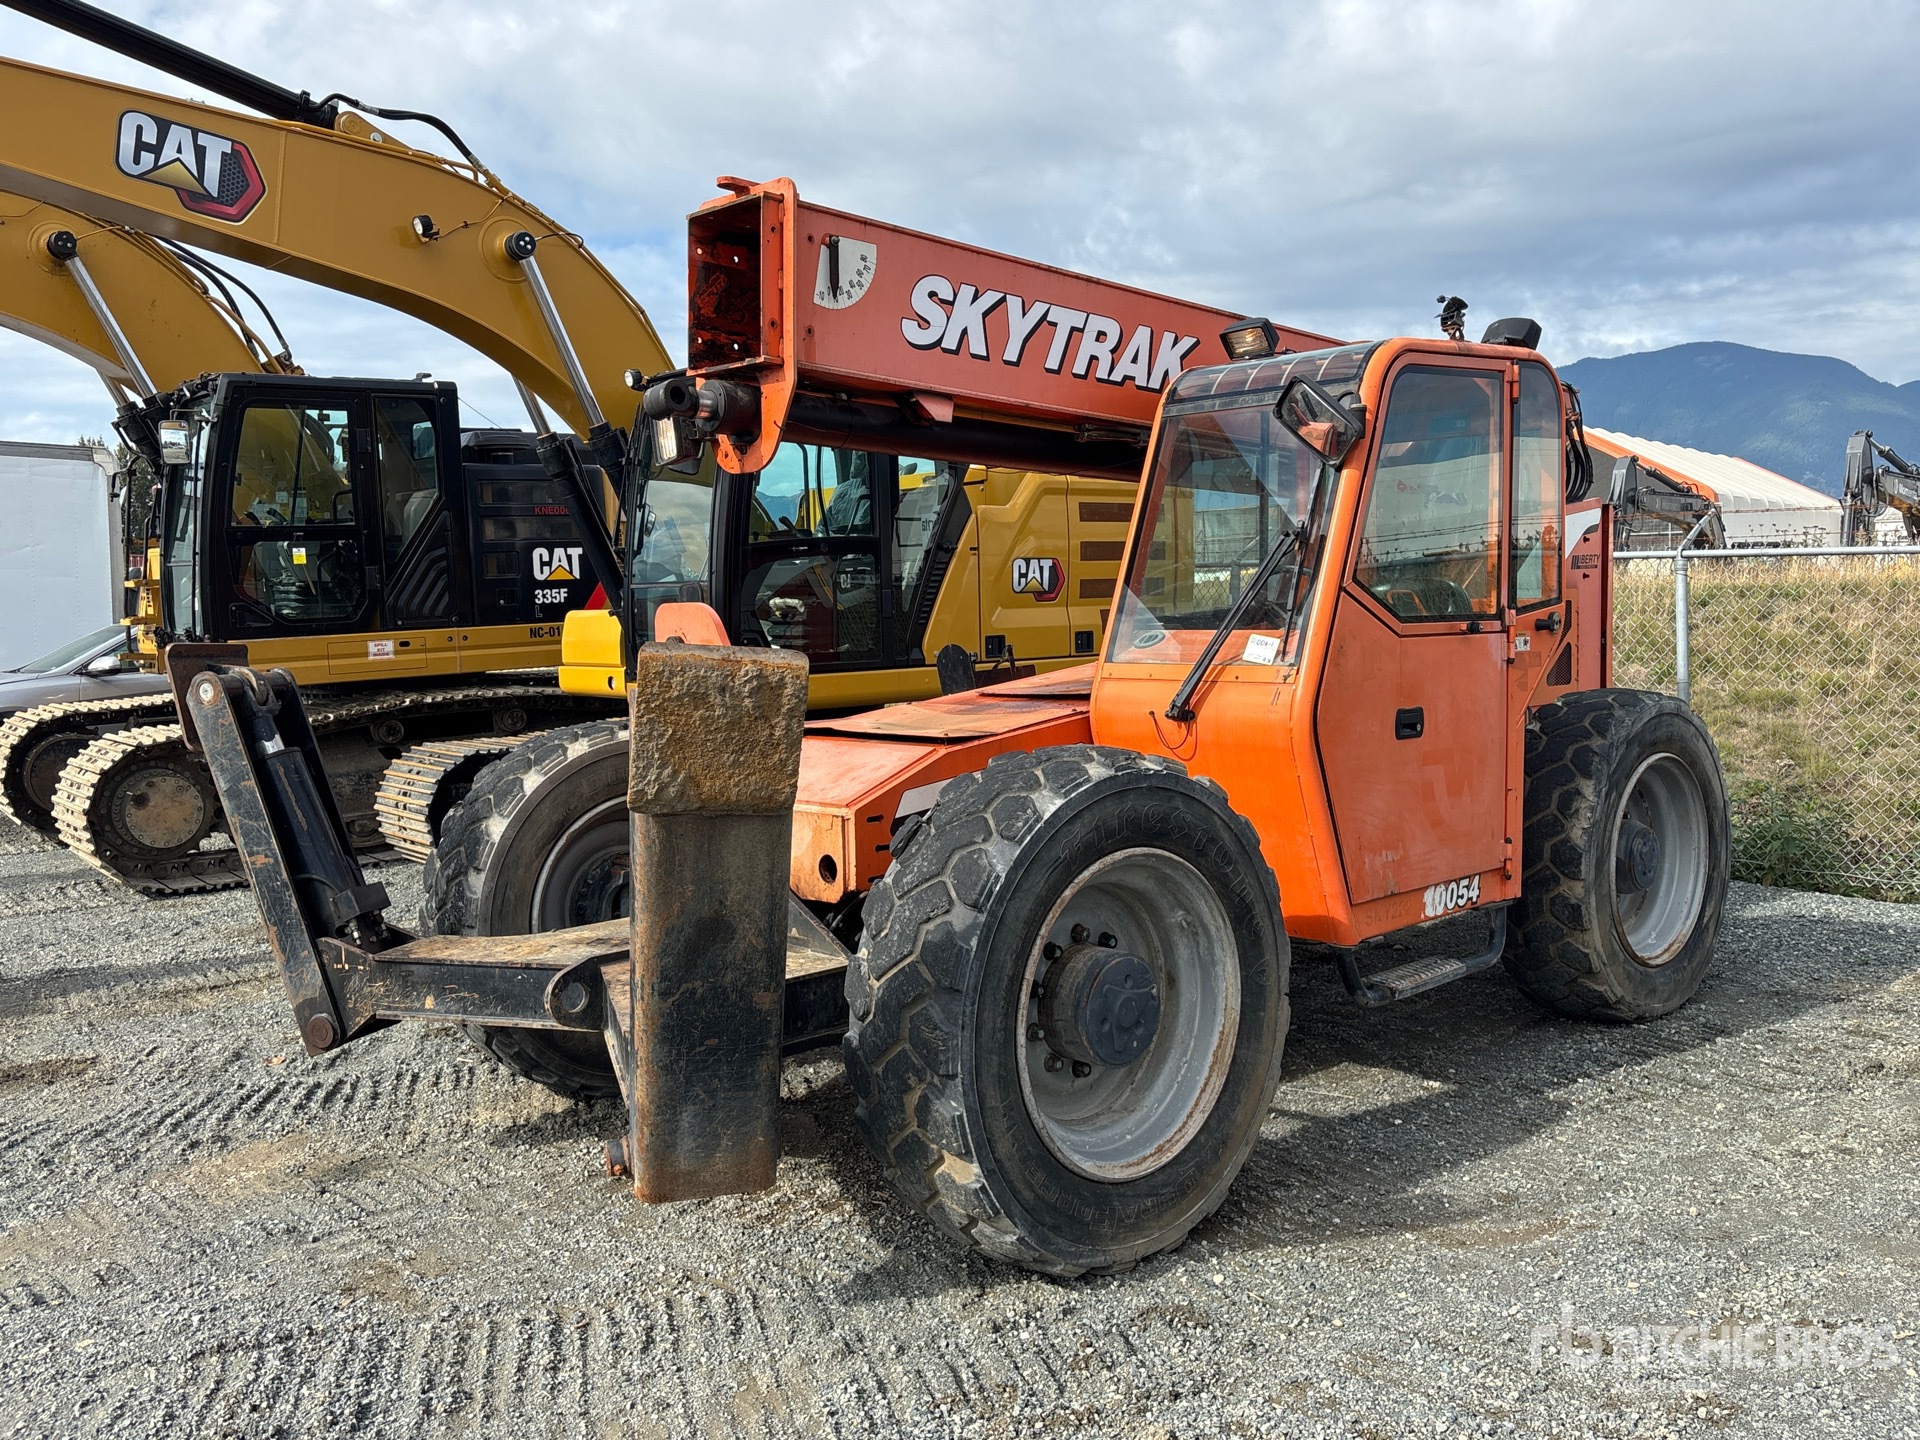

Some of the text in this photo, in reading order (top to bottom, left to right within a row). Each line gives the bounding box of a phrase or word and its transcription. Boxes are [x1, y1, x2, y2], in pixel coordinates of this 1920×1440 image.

[118, 111, 232, 198] CAT
[901, 274, 1200, 393] SKYTRAK
[532, 547, 583, 581] CAT
[1012, 558, 1053, 593] CAT
[534, 588, 568, 604] 335F
[534, 605, 543, 618] L
